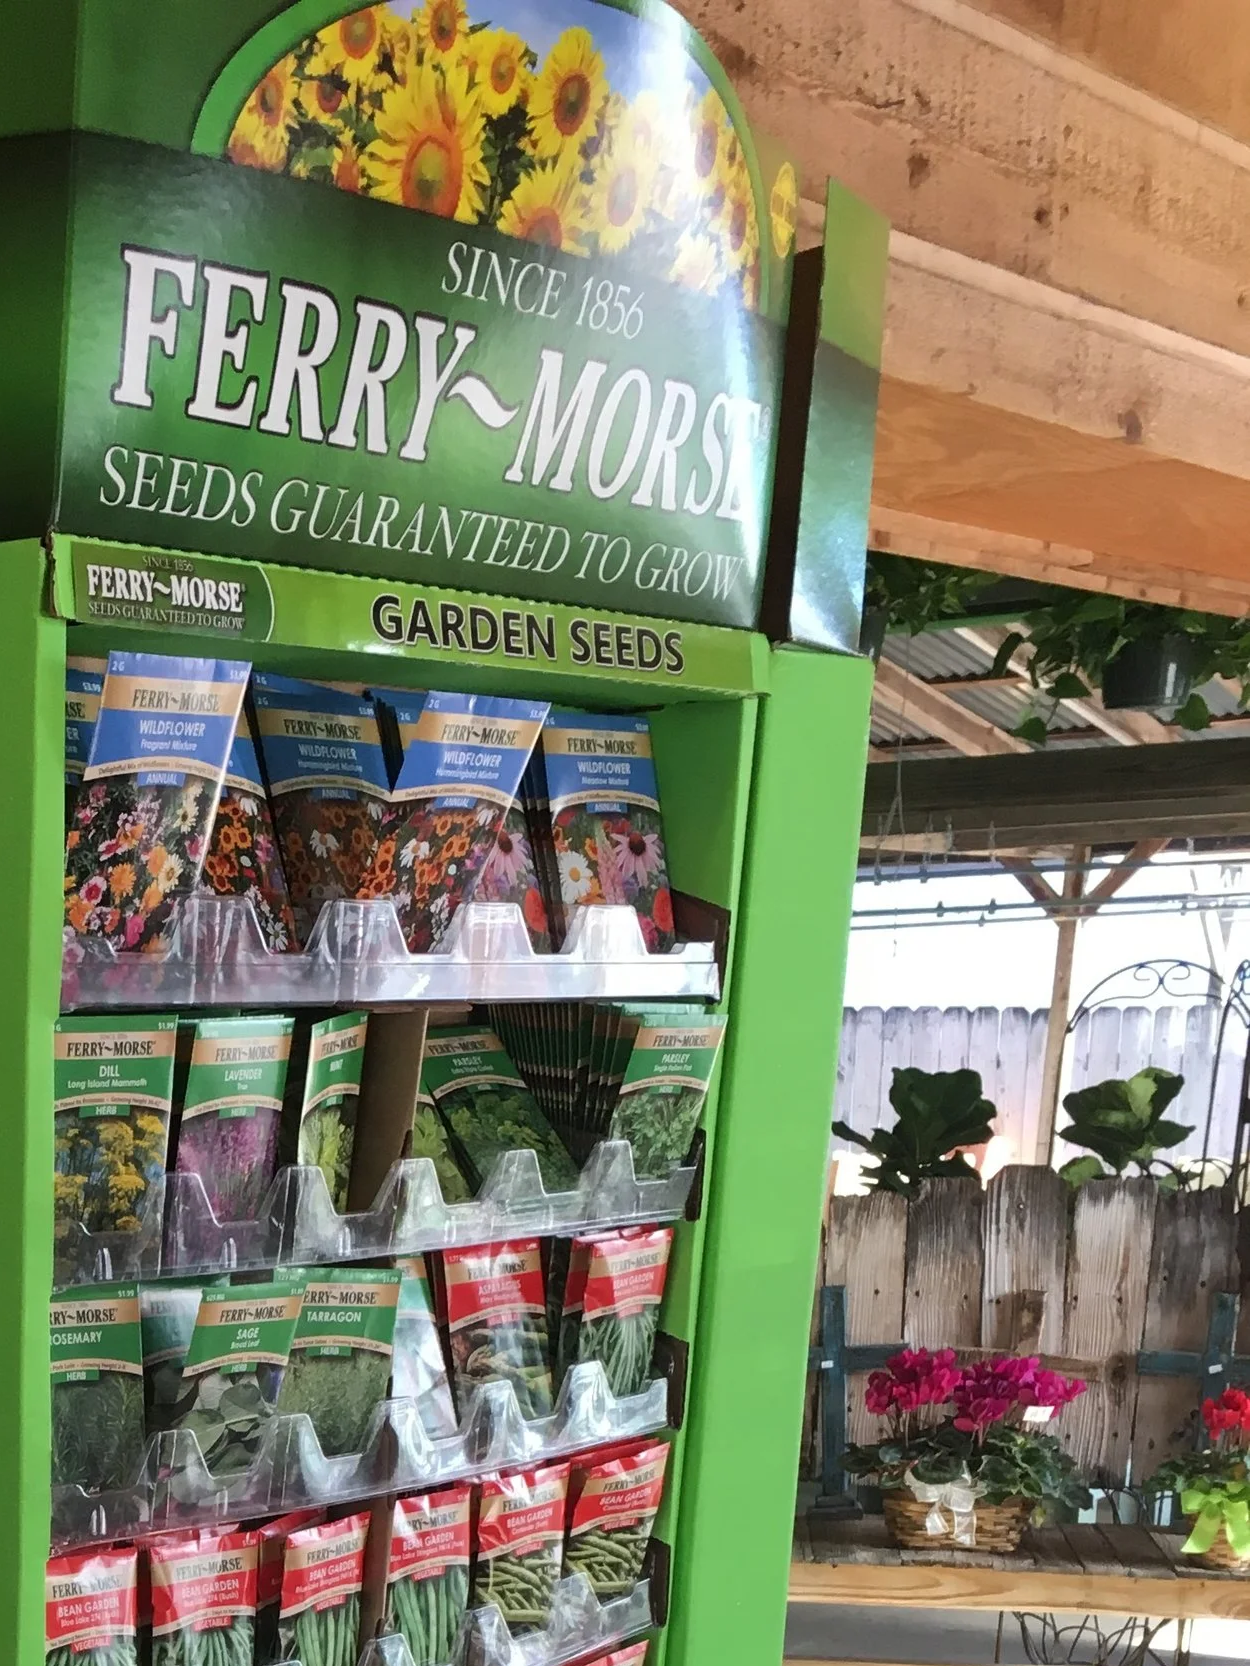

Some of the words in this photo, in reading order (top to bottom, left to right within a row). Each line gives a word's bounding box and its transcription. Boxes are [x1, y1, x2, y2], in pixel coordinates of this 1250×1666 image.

[441, 241, 567, 318] SINCE
[574, 277, 645, 341] 1856
[99, 444, 262, 529] SEEDS
[270, 478, 570, 573] GUARANTEED
[574, 530, 631, 582] TO
[635, 544, 746, 602] GROW
[142, 556, 171, 570] SINCE
[174, 559, 194, 572] 1856
[88, 602, 121, 616] SEEDS
[122, 605, 197, 624] GUARANTEED
[198, 613, 211, 626] TO
[213, 616, 245, 630] GROW
[370, 593, 556, 660] GARDEN
[569, 618, 685, 675] SEEDS
[139, 719, 206, 737] WILDFLOWER
[140, 738, 171, 750] Fragrant
[171, 740, 197, 751] Mixture
[298, 744, 357, 760] WILDFLOWER
[443, 749, 502, 768] WILDFLOWER
[477, 769, 499, 780] Mixture
[577, 761, 632, 775] WILDFLOWER
[145, 773, 179, 784] ANNUAL
[321, 789, 352, 798] ANNUAL
[442, 797, 469, 808] ANNUAL
[593, 802, 622, 813] ANNUAL
[158, 1022, 175, 1030] $1.99
[452, 1056, 482, 1067] PARSLEY
[661, 1053, 690, 1063] PARSLEY
[99, 1065, 120, 1078] DILL
[224, 1069, 262, 1082] LAVENDER
[68, 1080, 86, 1089] Long
[87, 1079, 110, 1088] Island
[110, 1078, 147, 1088] Mammoth
[95, 1105, 117, 1115] HERB
[117, 1289, 135, 1298] $1.99
[307, 1311, 362, 1323] TARRAGON
[236, 1327, 259, 1340] SAGE
[320, 1346, 340, 1355] HERB
[66, 1371, 87, 1381] HERB
[600, 1494, 622, 1506] BEAN
[623, 1487, 651, 1503] GARDEN
[506, 1516, 526, 1528] BEAN
[526, 1508, 554, 1523] GARDEN
[403, 1538, 424, 1551] BEAN
[424, 1532, 454, 1548] GARDEN
[309, 1570, 330, 1583] BEAN
[331, 1561, 357, 1578] GARDEN
[181, 1586, 200, 1600] BEAN
[201, 1579, 240, 1596] GARDEN
[57, 1604, 82, 1619] BEAN
[83, 1596, 120, 1614] GARDEN
[74, 1637, 111, 1651] VEGETABLE
